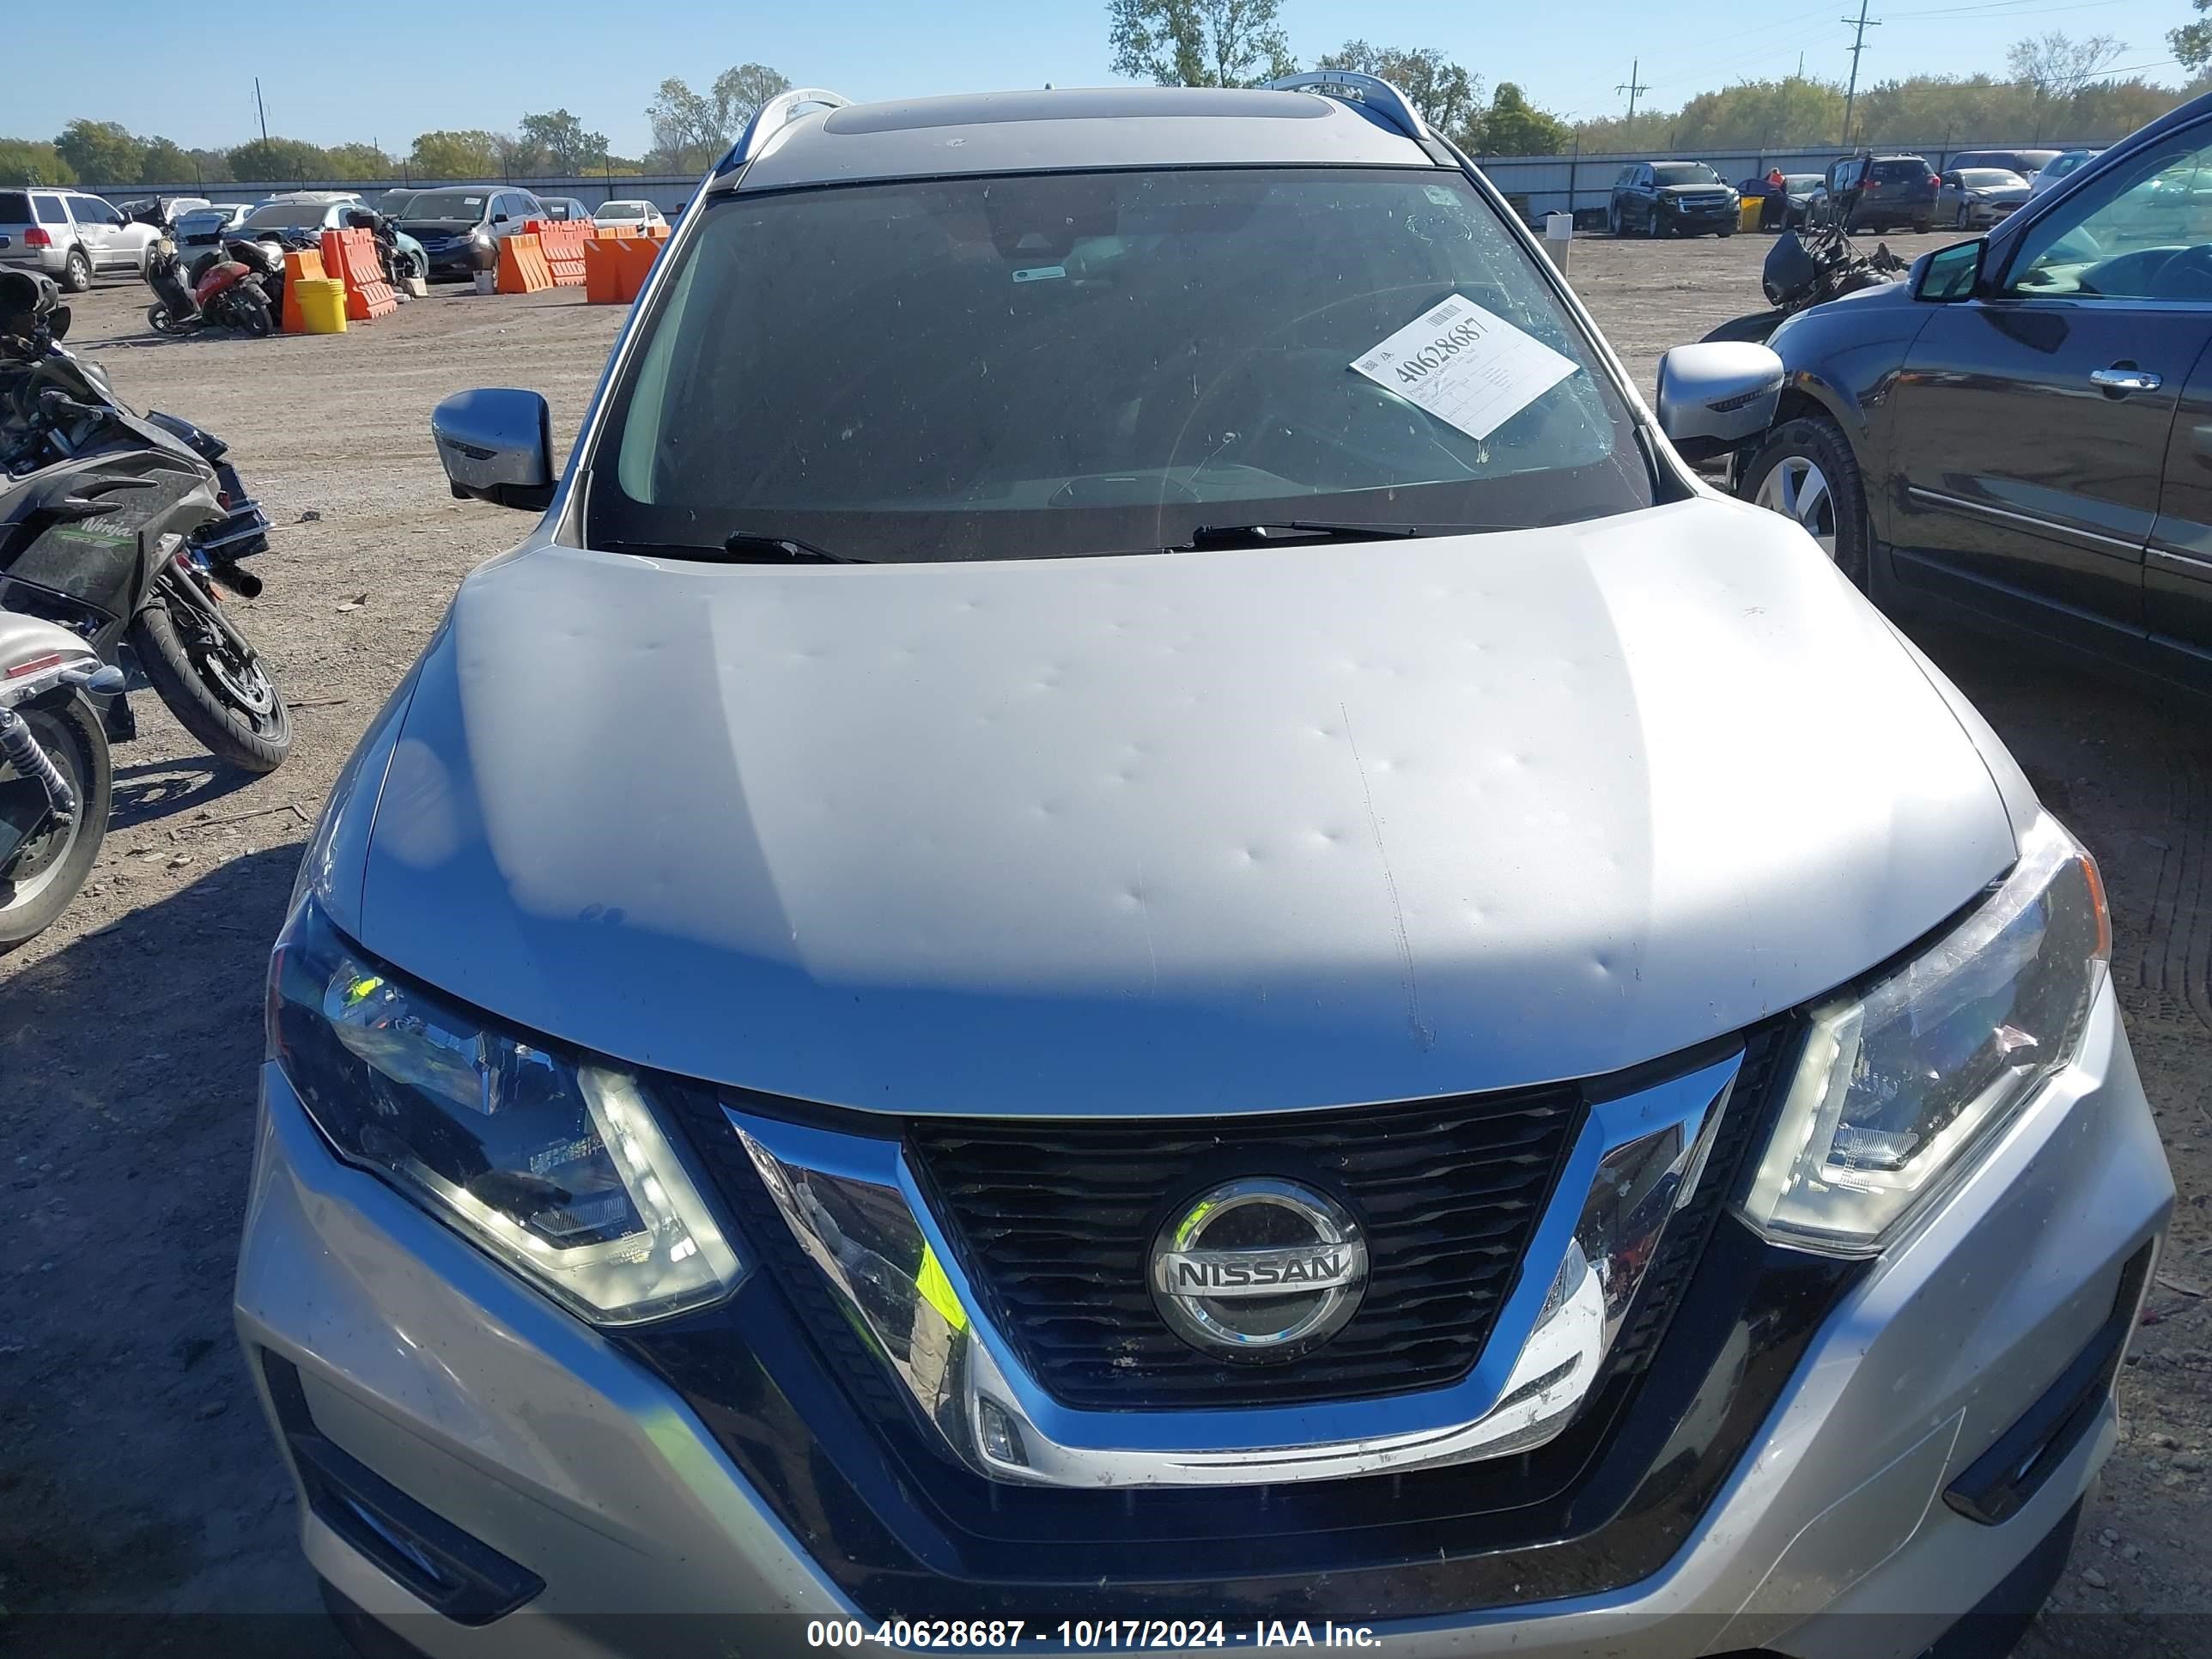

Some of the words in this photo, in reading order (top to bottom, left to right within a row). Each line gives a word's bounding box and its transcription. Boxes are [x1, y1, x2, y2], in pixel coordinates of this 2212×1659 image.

[1395, 317, 1489, 383] 40628687
[82, 517, 133, 537] Ninja
[1178, 1254, 1340, 1286] NISSAN
